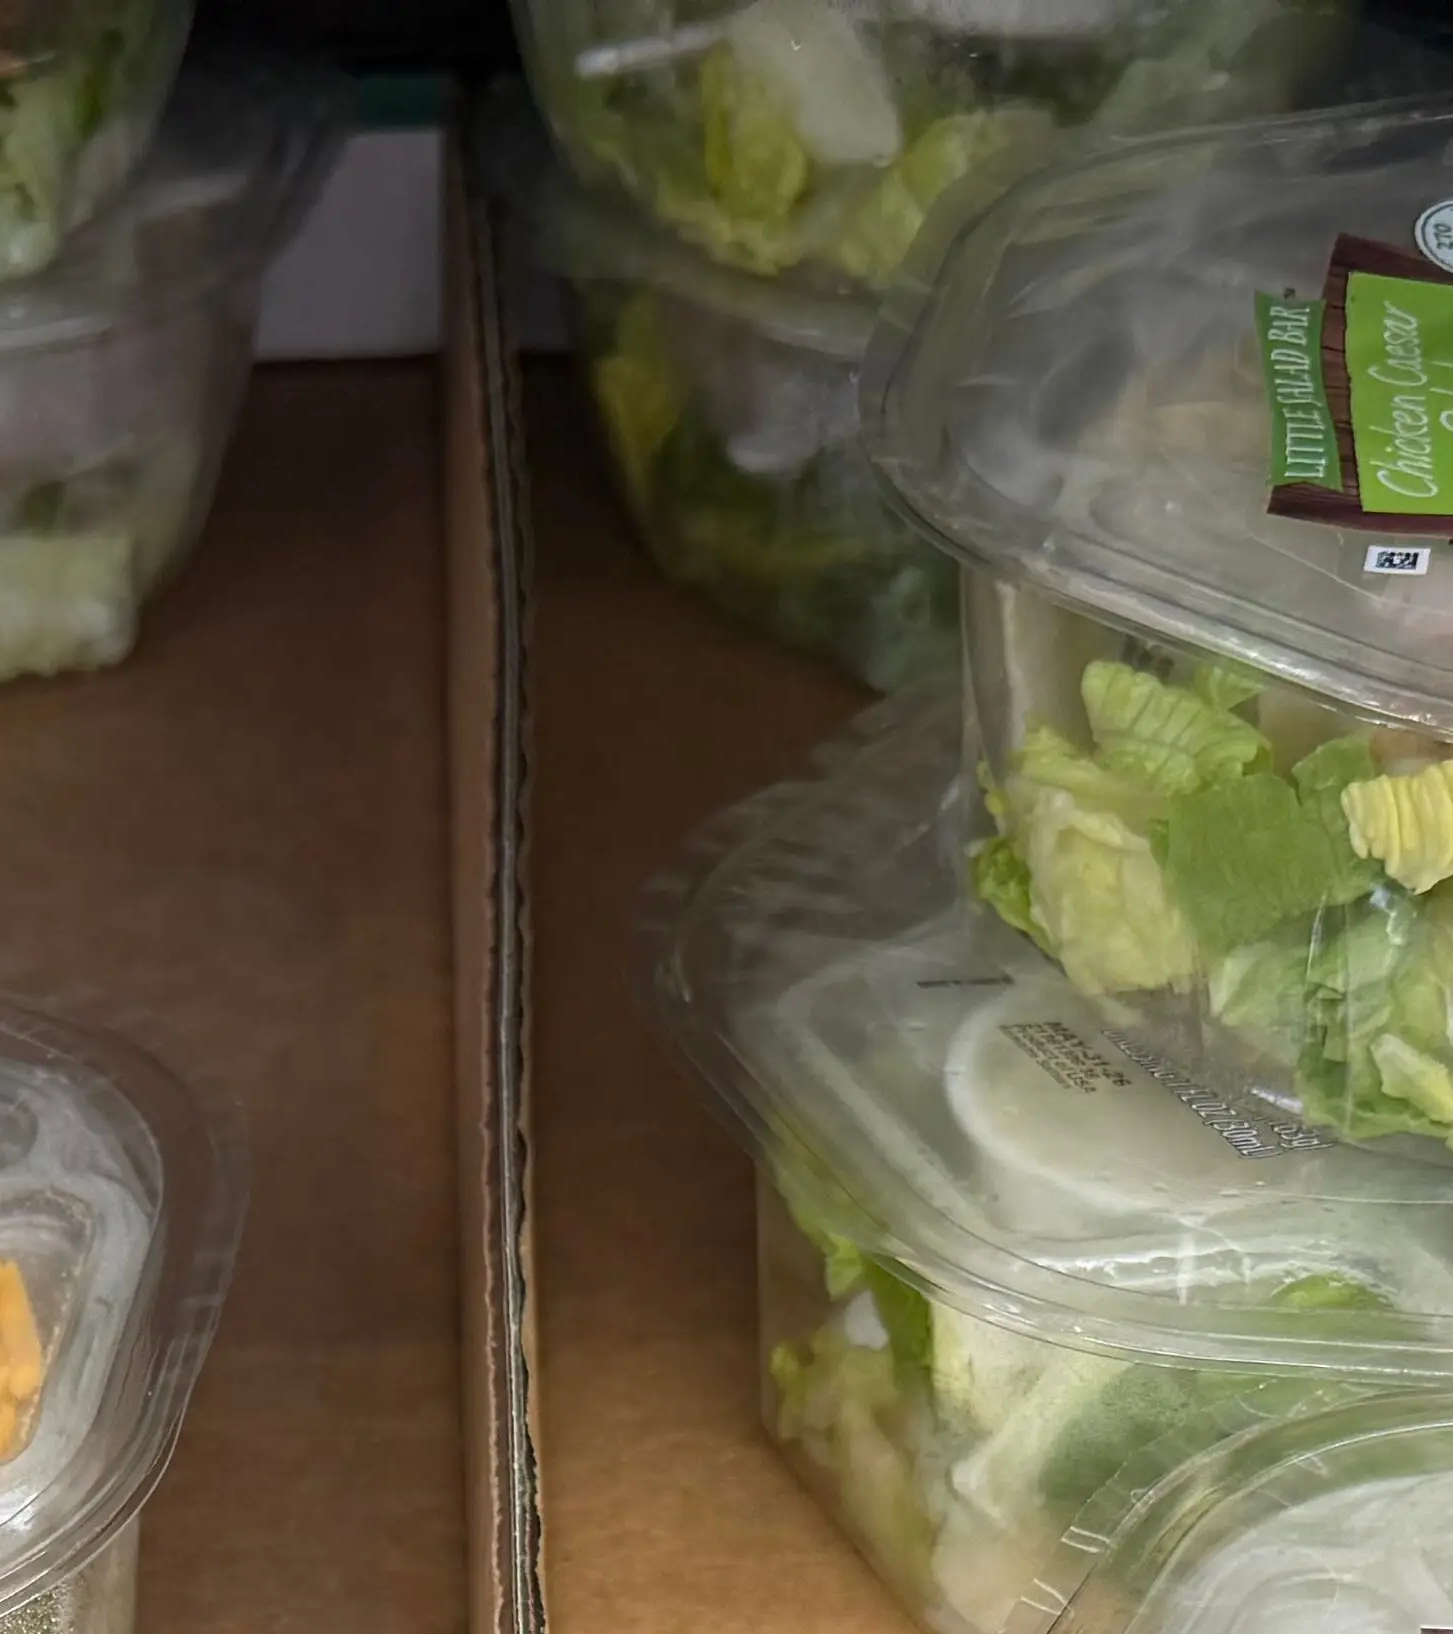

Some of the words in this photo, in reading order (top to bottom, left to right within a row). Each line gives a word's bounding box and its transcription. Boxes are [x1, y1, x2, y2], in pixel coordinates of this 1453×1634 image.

[1267, 306, 1311, 346] BAR
[1367, 300, 1428, 387] Caesar
[1270, 348, 1323, 407] SALAD
[1282, 408, 1326, 478] LITTLE
[1368, 394, 1438, 498] Chicken
[1202, 1118, 1284, 1160] (30mL)
